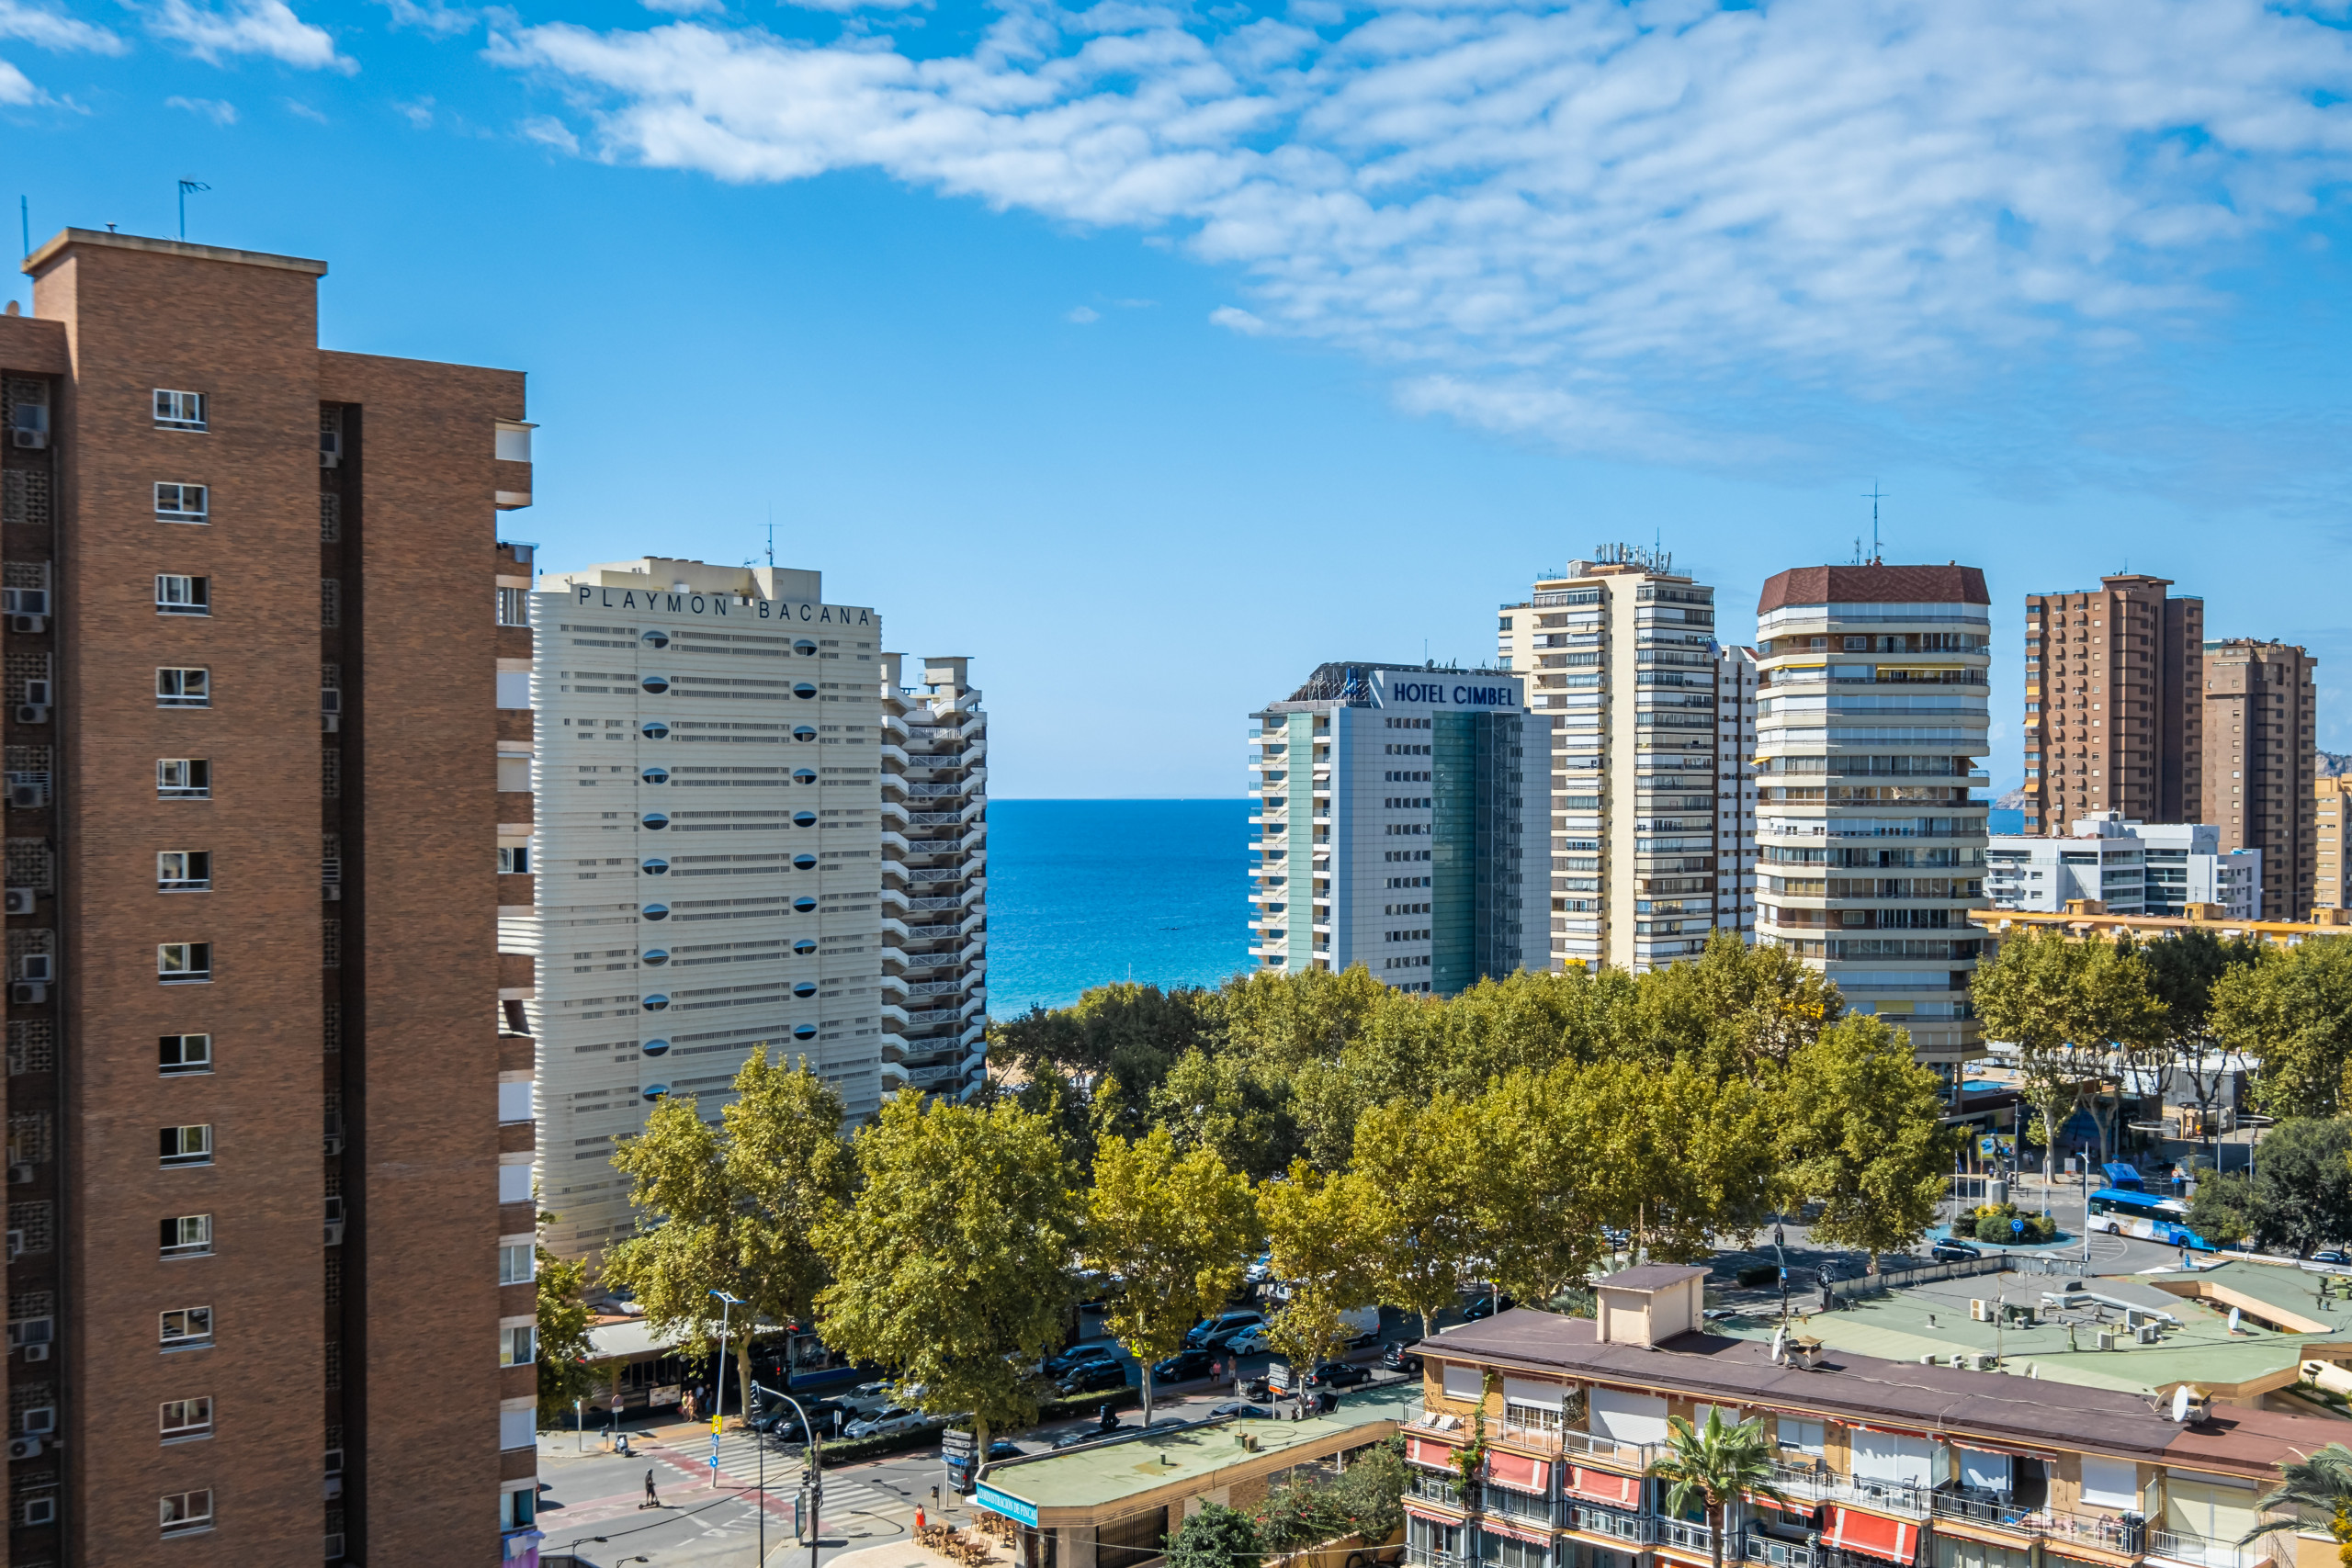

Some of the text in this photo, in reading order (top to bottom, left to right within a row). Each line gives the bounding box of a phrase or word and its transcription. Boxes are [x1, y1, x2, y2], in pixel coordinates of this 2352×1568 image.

[579, 587, 870, 626] PLAYMON BACANA
[1394, 682, 1515, 705] HOTEL CIMBEL
[978, 1488, 1037, 1521] ADMINISTRACIÓN DE FINCAS
